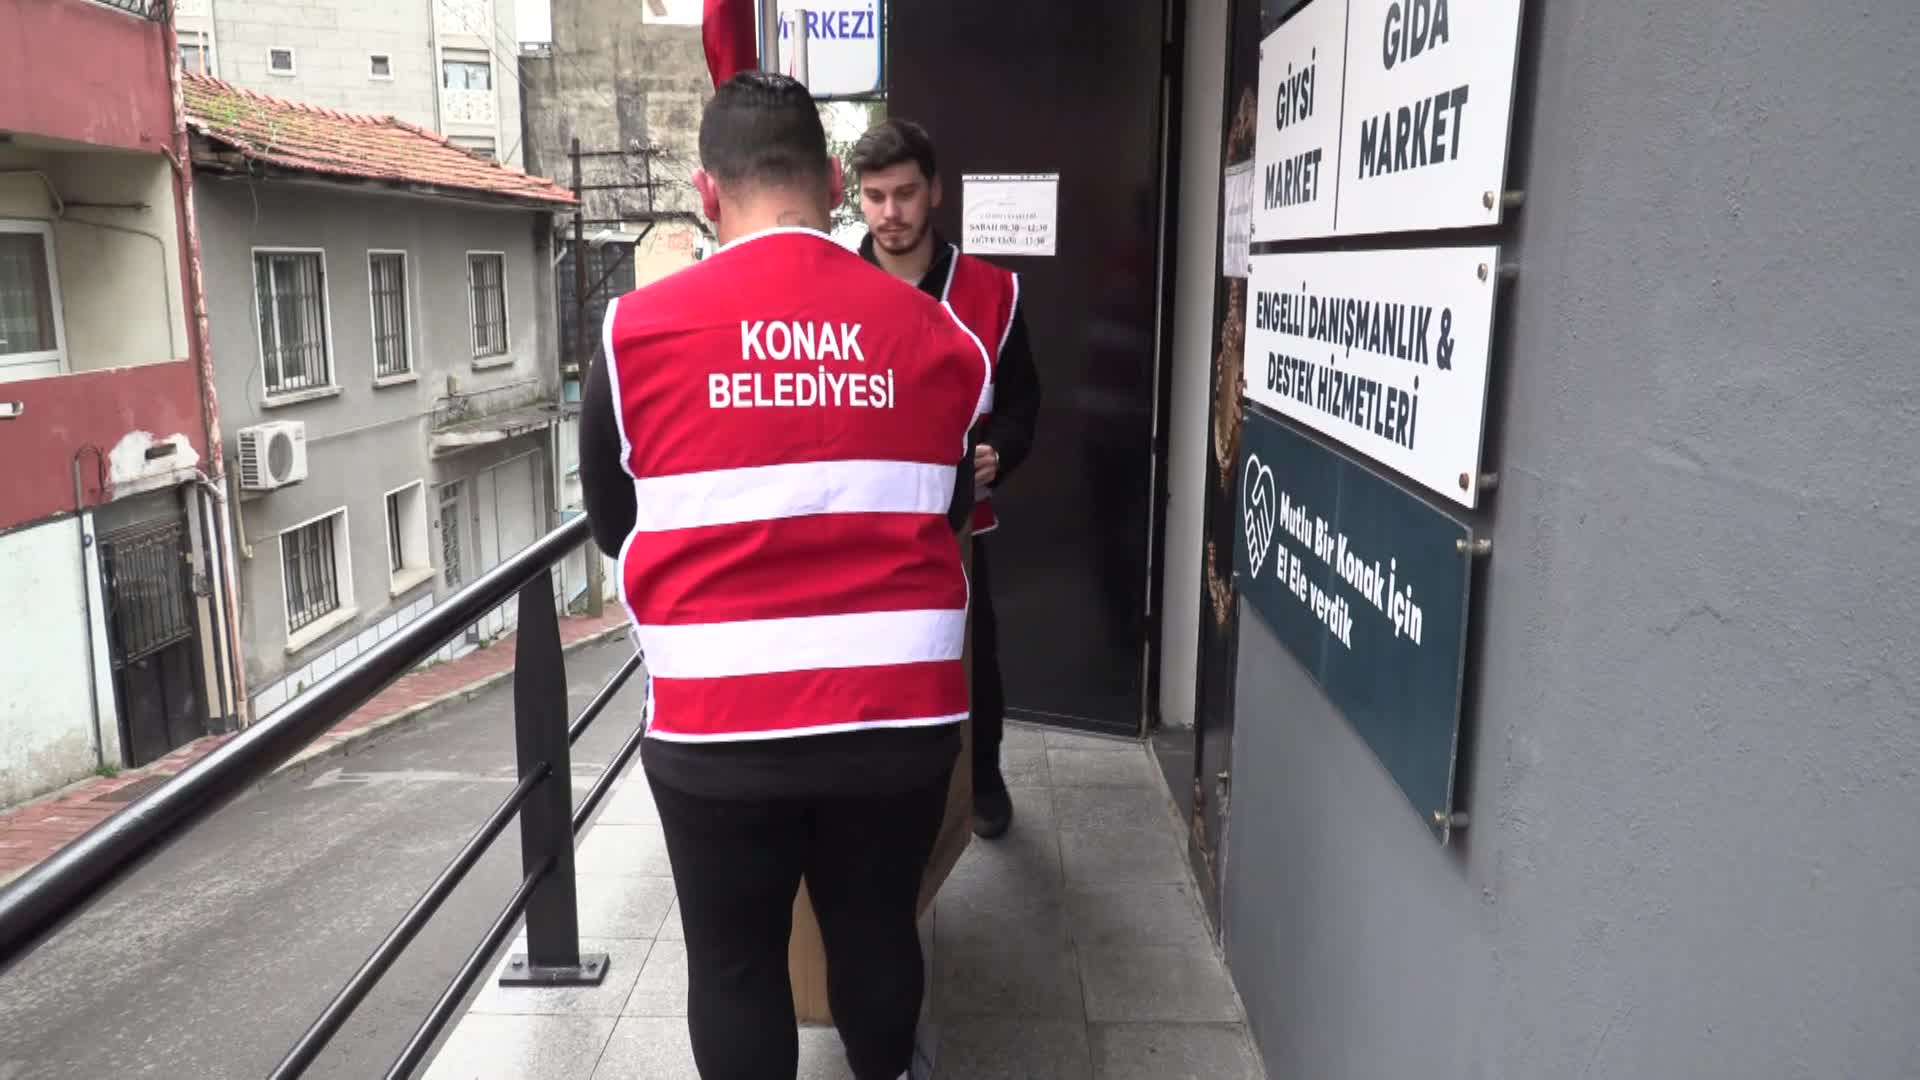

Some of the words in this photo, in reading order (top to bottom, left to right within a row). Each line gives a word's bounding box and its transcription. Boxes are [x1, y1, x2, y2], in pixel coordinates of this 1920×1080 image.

[778, 3, 875, 39] RKEZİ
[1383, 0, 1449, 70] GIDA
[1276, 47, 1316, 131] GİYSİ
[1358, 84, 1469, 180] MARKET
[1264, 147, 1322, 210] MARKET
[741, 320, 864, 361] KONAK
[1256, 281, 1306, 337] ENGELLİ
[1308, 295, 1432, 365] DANIŞMANLIK
[1436, 307, 1455, 371] &
[708, 365, 894, 408] BELEDİYESİ
[1267, 352, 1316, 406] DESTEK
[1317, 353, 1419, 450] HİZMETLERİ
[1277, 543, 1288, 584] El
[1289, 556, 1308, 602] Ele
[1310, 581, 1353, 650] verdik
[1279, 491, 1312, 549] Mutlu
[1314, 516, 1335, 565] Bir
[1336, 532, 1384, 612] Konak
[1387, 557, 1423, 646] İçin
